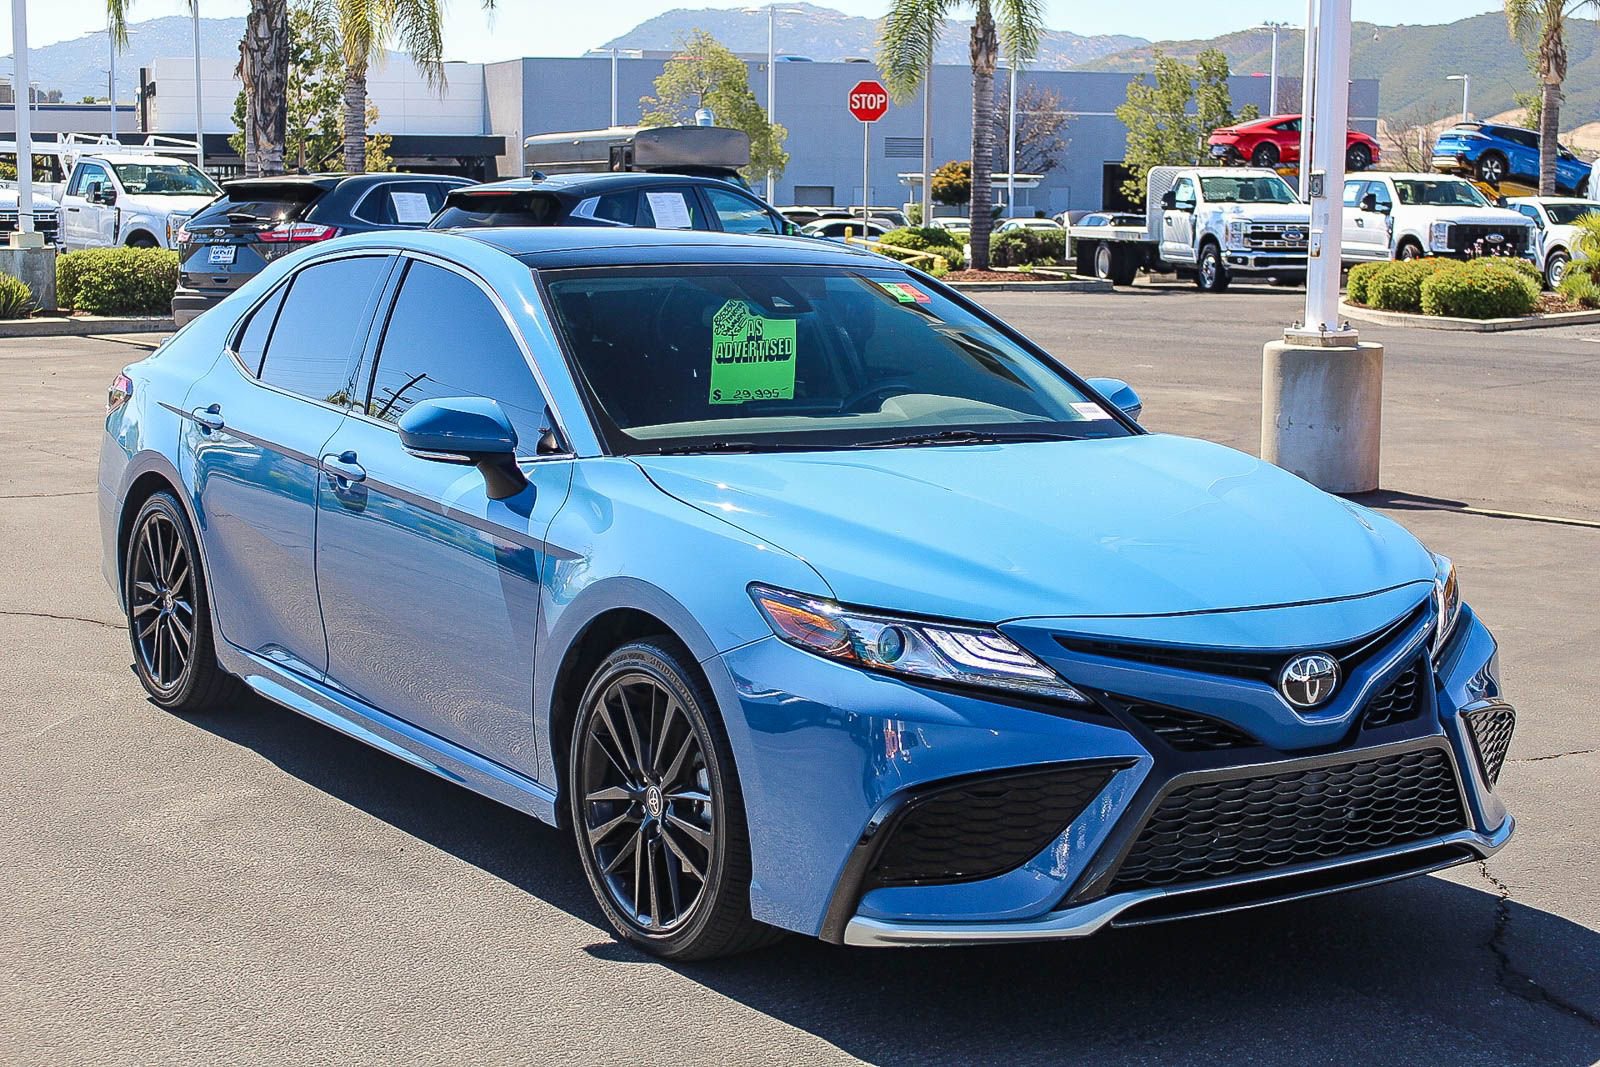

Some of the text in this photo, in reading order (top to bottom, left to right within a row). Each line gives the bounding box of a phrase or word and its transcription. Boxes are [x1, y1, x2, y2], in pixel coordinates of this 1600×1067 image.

[851, 93, 886, 110] STOP
[747, 318, 763, 339] AS
[715, 338, 793, 363] ADVERTISED
[713, 388, 722, 401] $
